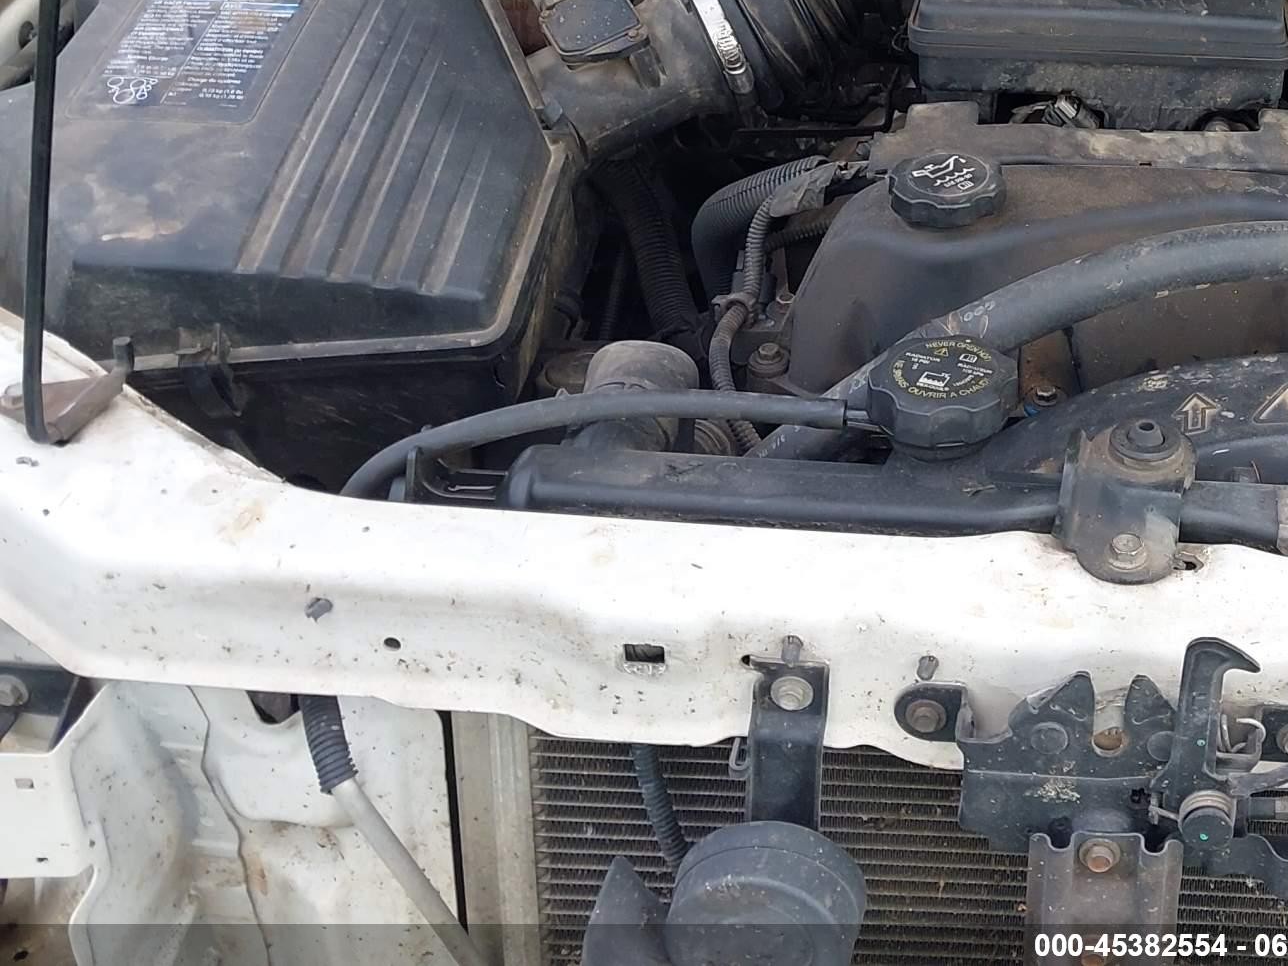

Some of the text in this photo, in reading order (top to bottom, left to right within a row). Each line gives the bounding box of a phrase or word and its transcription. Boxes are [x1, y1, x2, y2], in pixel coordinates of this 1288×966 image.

[925, 340, 956, 349] NEVER
[956, 341, 979, 353] OPEN
[905, 352, 941, 363] RADIATOR
[907, 386, 947, 399] OUVRIR
